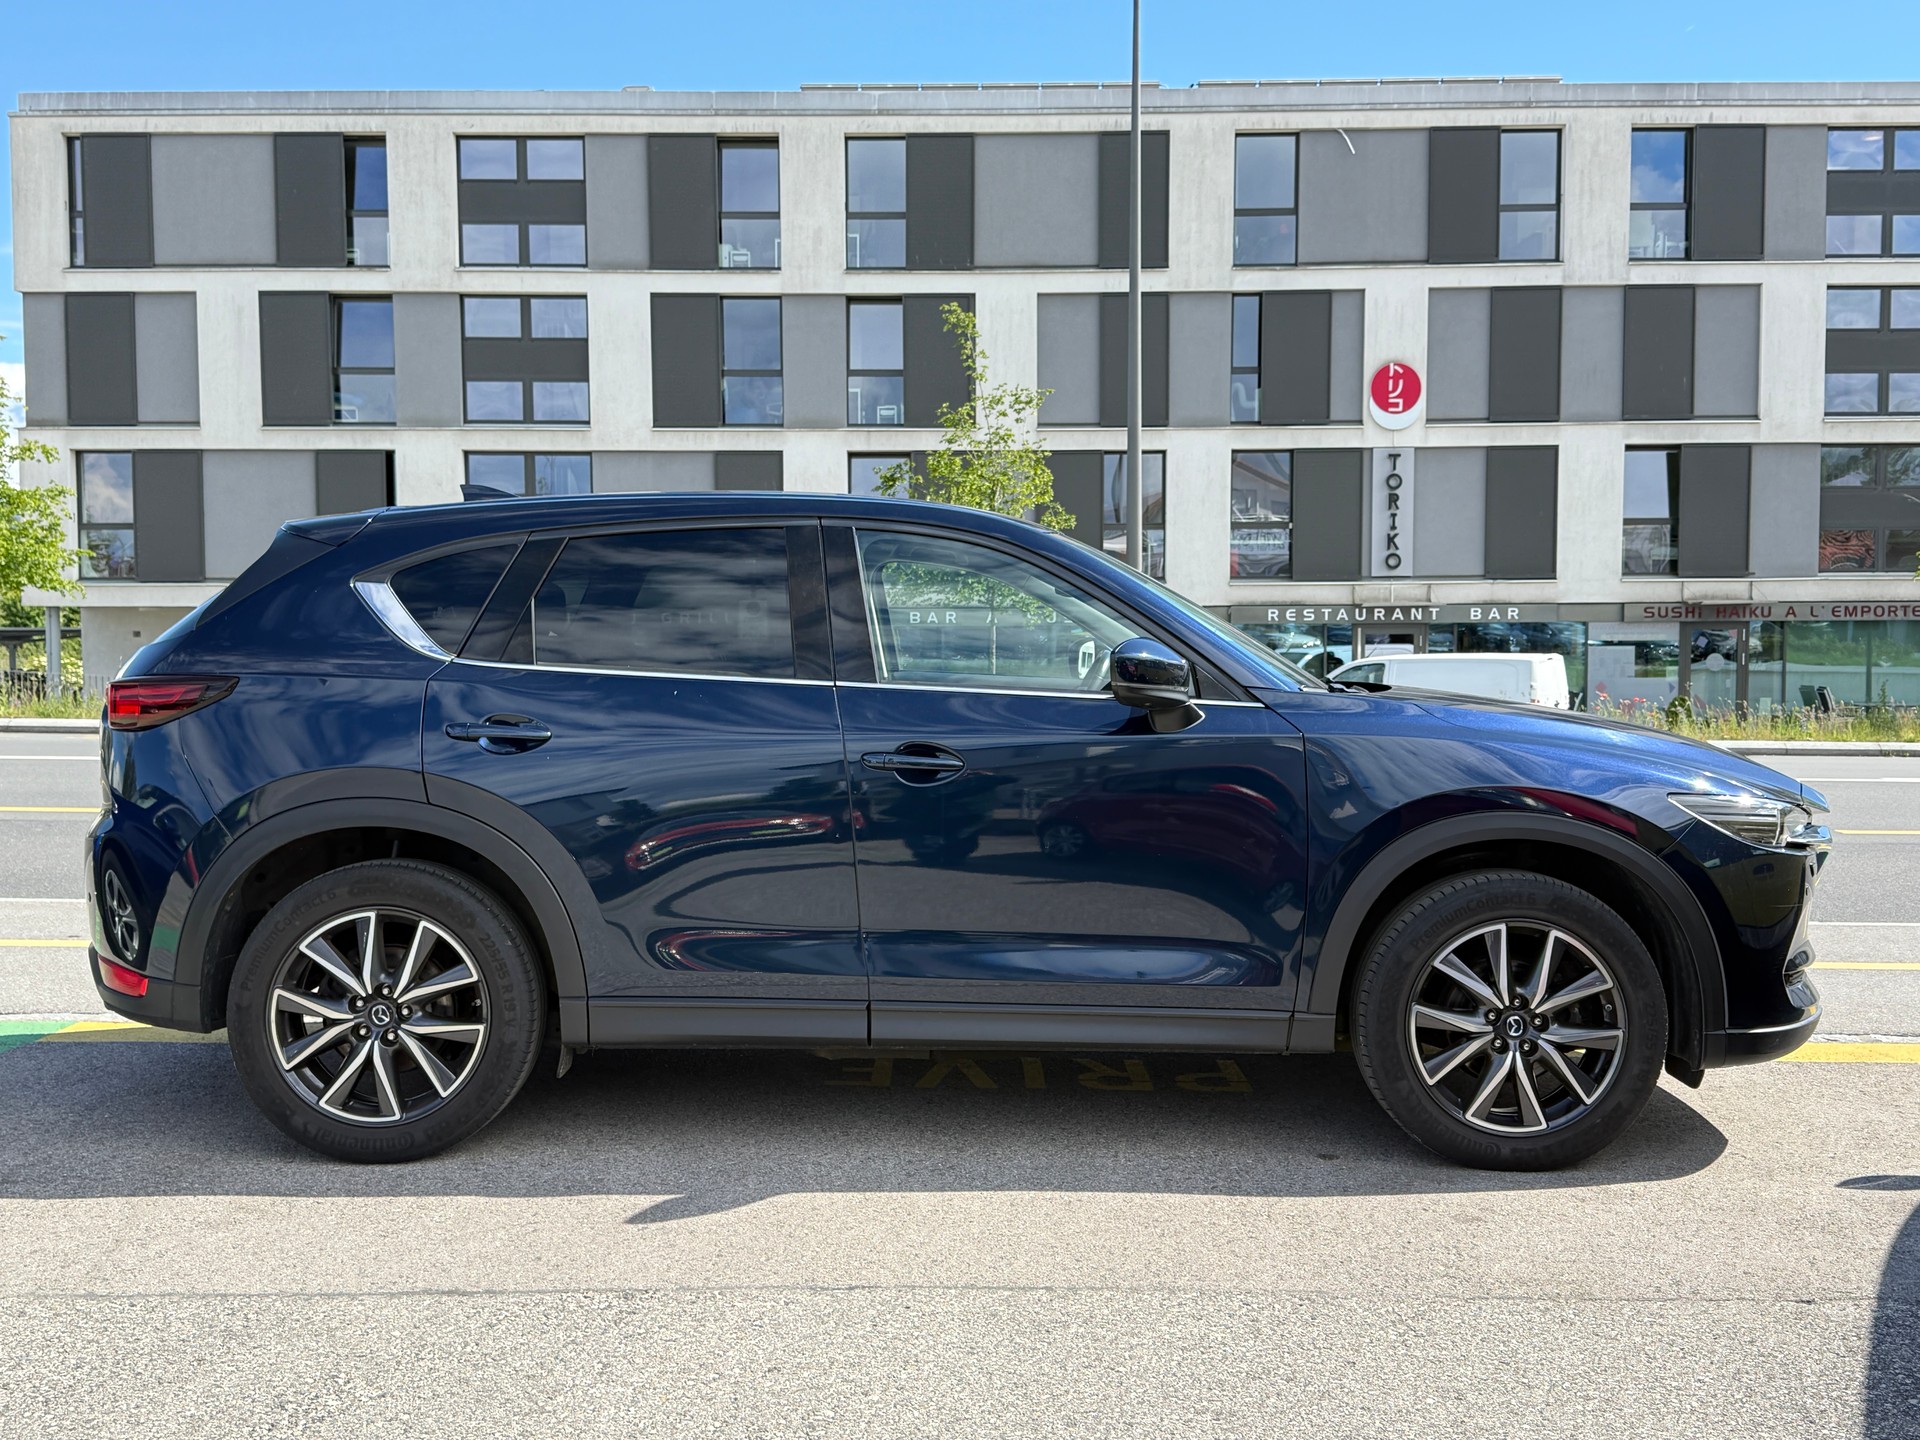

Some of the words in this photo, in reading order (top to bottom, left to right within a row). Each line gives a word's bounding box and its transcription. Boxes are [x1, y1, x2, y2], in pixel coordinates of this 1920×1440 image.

[1388, 362, 1404, 412] トリコ
[1385, 453, 1403, 570] TORIKO
[909, 611, 957, 625] BAR
[1267, 607, 1440, 621] RESTAURANT
[1470, 607, 1519, 620] BAR
[1643, 605, 1702, 619] SUSHI
[1715, 605, 1773, 619] HAIKU
[1785, 606, 1797, 618] A
[824, 1057, 1254, 1092] PRIVE
